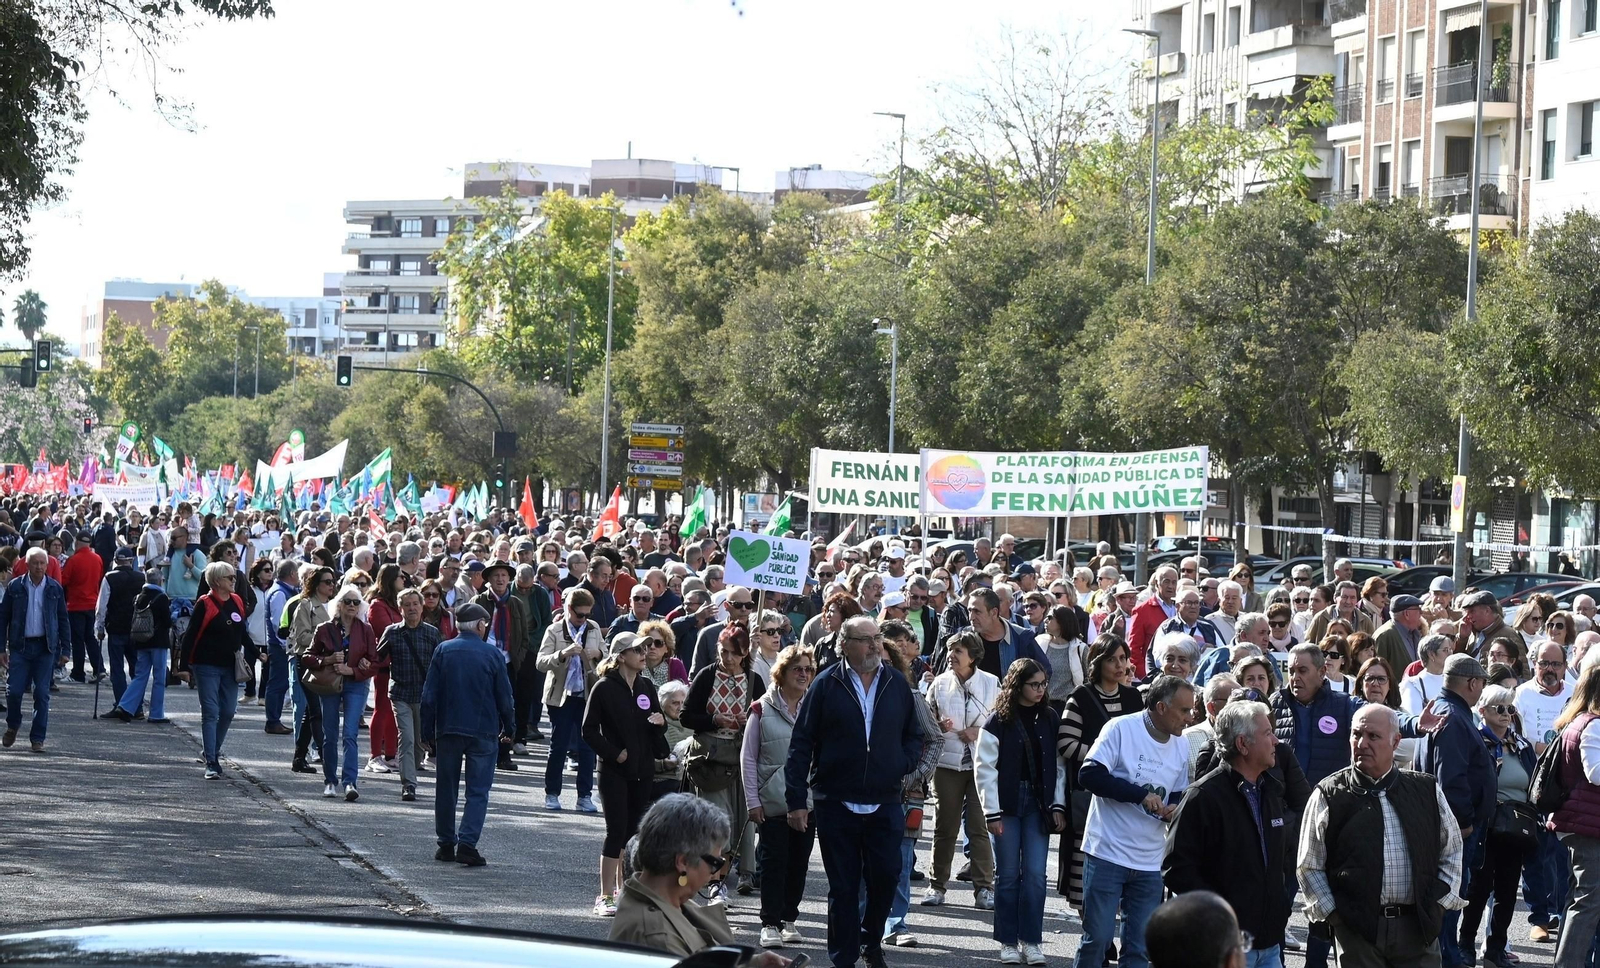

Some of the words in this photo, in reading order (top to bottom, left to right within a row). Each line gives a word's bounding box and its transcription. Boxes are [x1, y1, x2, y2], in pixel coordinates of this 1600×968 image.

[996, 455, 1105, 467] PLATAFORMA
[1109, 456, 1129, 466] EN
[1131, 451, 1200, 465] DEFENSA
[831, 460, 908, 482] FERNÁN
[991, 471, 1013, 483] DE
[1018, 472, 1039, 484] LA
[1043, 471, 1111, 484] SANIDAD
[1115, 467, 1180, 482] PÚBLICA
[1184, 467, 1204, 479] DE
[817, 487, 859, 507] UNA
[991, 487, 1105, 511] FERNÁN
[1113, 484, 1203, 509] NÚÑEZ
[772, 541, 784, 551] LA
[753, 573, 763, 583] NO
[762, 575, 774, 585] SE
[775, 576, 799, 588] VENDE
